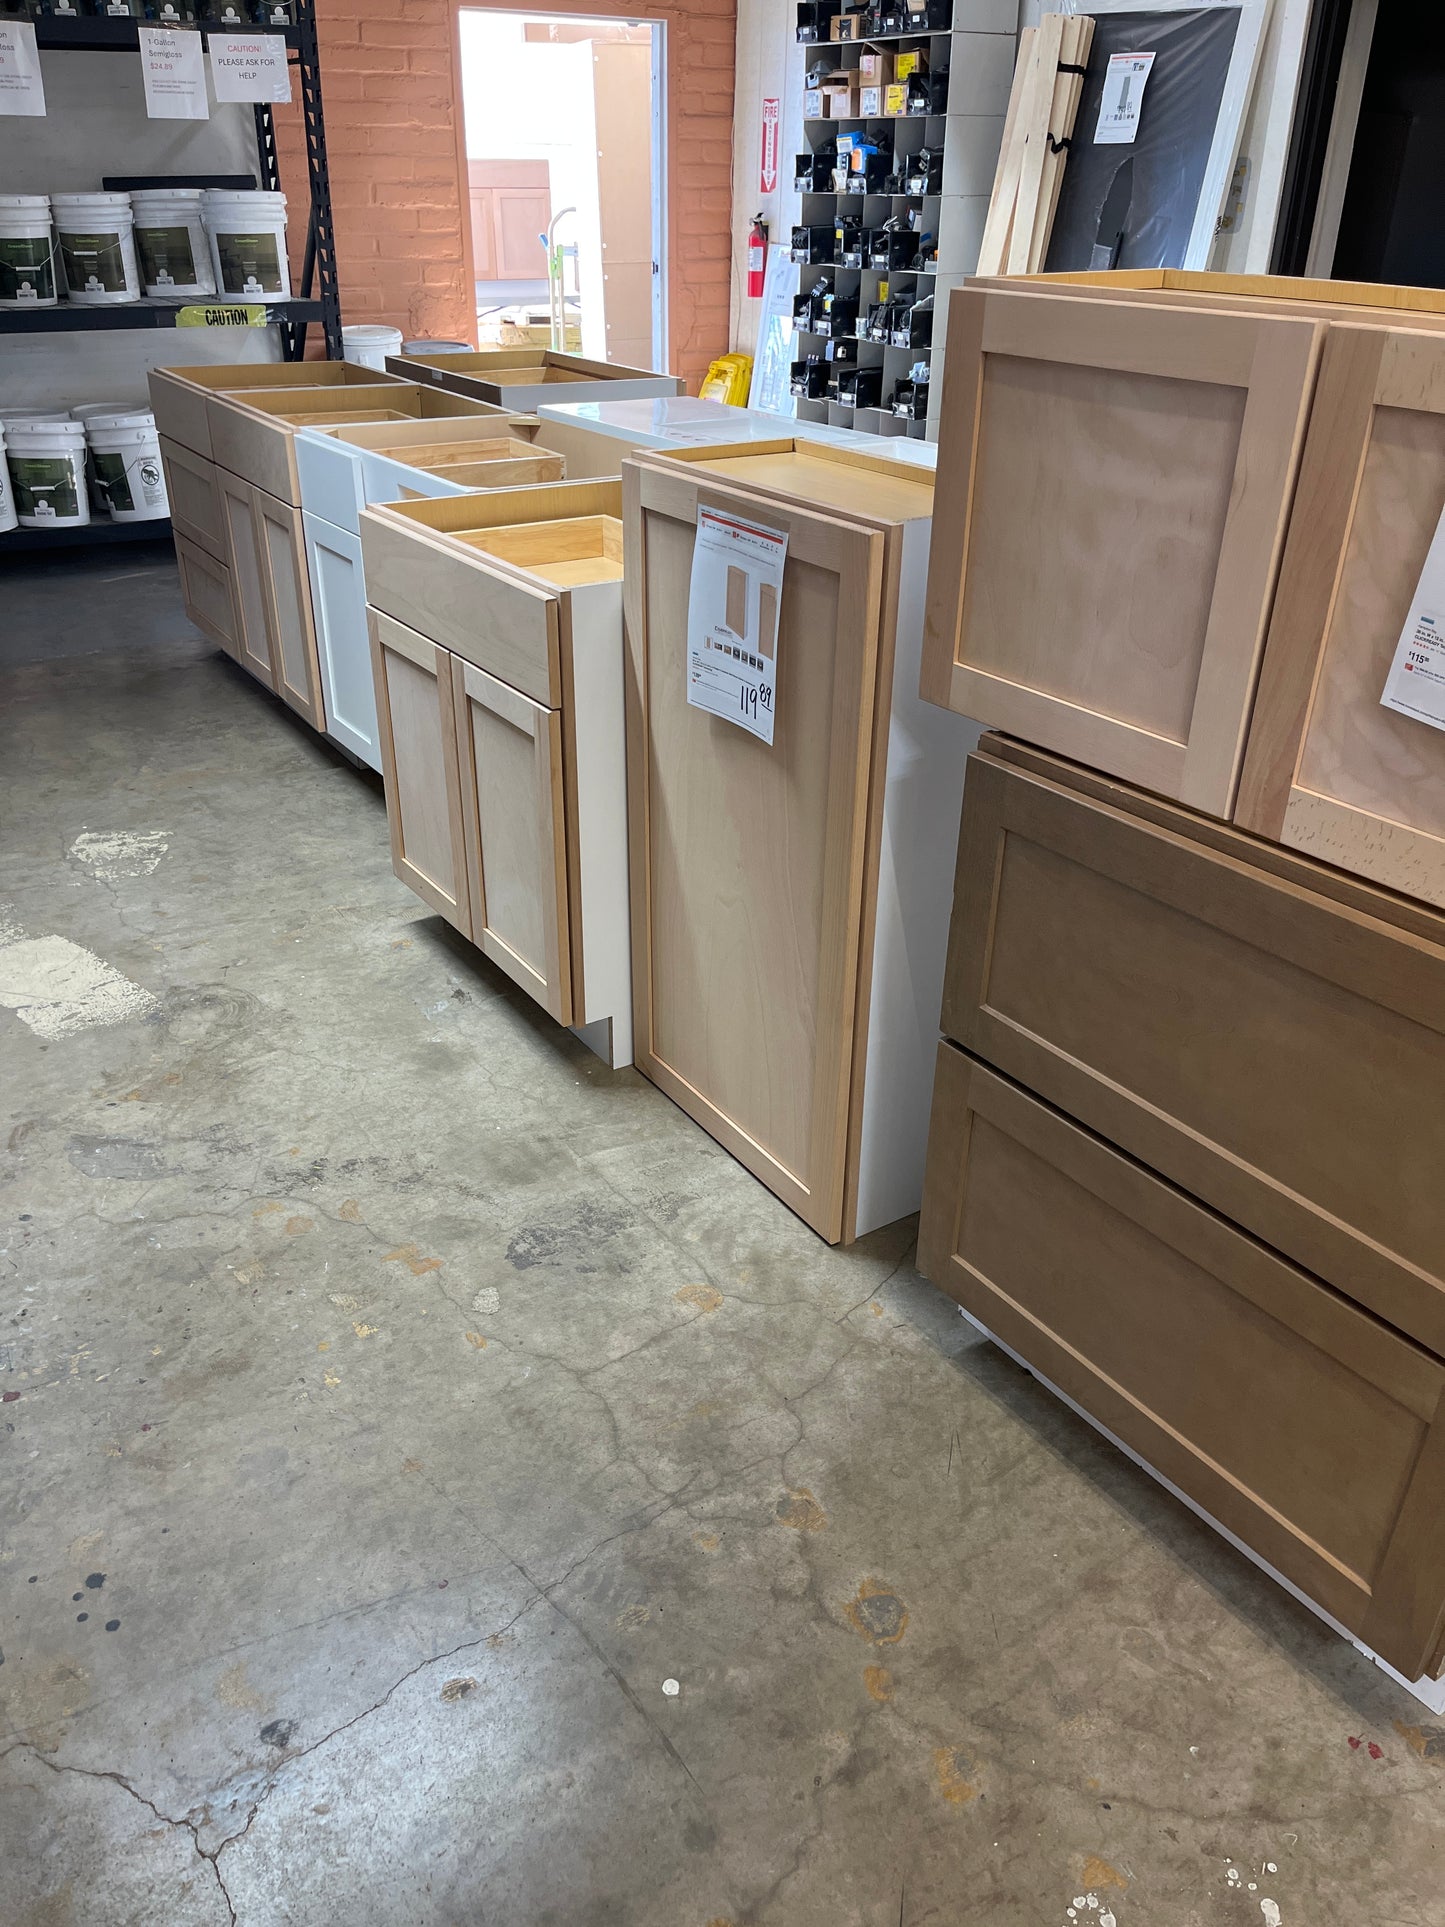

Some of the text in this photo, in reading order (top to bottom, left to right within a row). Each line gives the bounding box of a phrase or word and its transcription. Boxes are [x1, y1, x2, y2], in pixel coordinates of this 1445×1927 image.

[153, 38, 176, 46] Gallon
[227, 45, 262, 53] CAUTION!
[148, 49, 182, 59] Semigloss
[218, 58, 275, 66] PLEASE ASK FOR
[238, 71, 257, 79] HELP
[765, 106, 777, 118] FIRE
[205, 309, 249, 326] CAUTION
